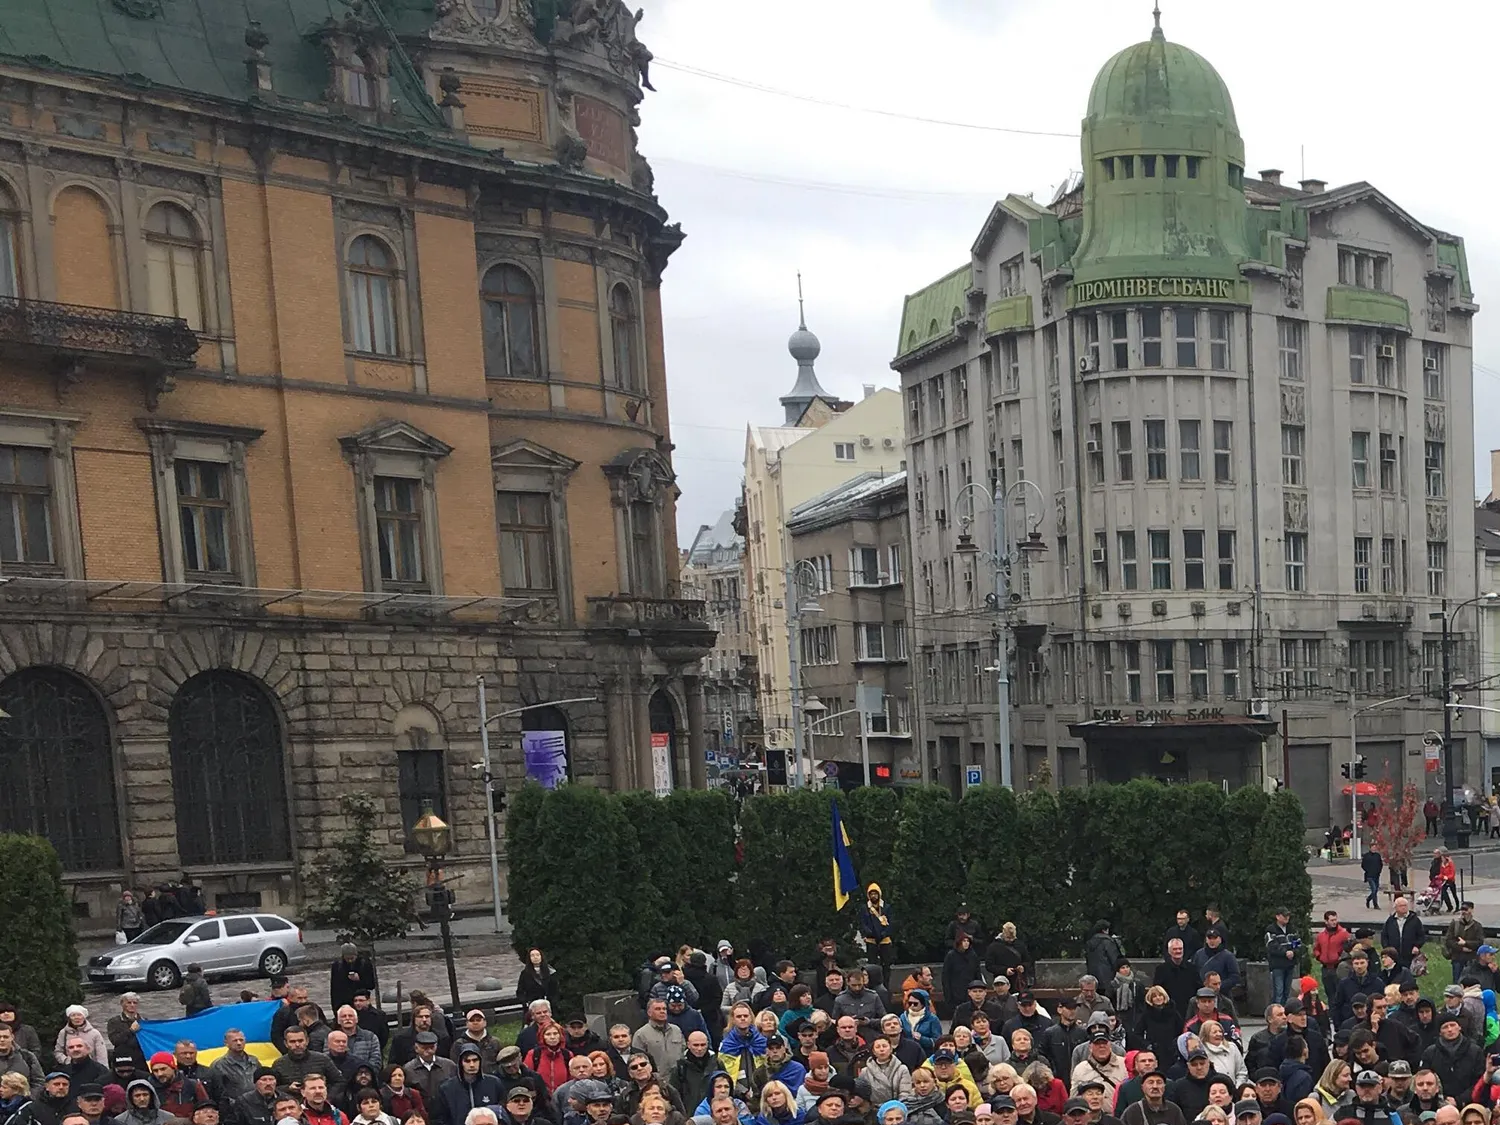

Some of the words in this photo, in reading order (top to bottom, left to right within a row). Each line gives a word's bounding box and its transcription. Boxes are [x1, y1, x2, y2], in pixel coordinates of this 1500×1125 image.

[1077, 277, 1230, 301] ПРОМІНВЕСТБАНК
[1135, 709, 1174, 722] BANK
[1186, 707, 1225, 721] БАНК
[971, 772, 978, 782] P
